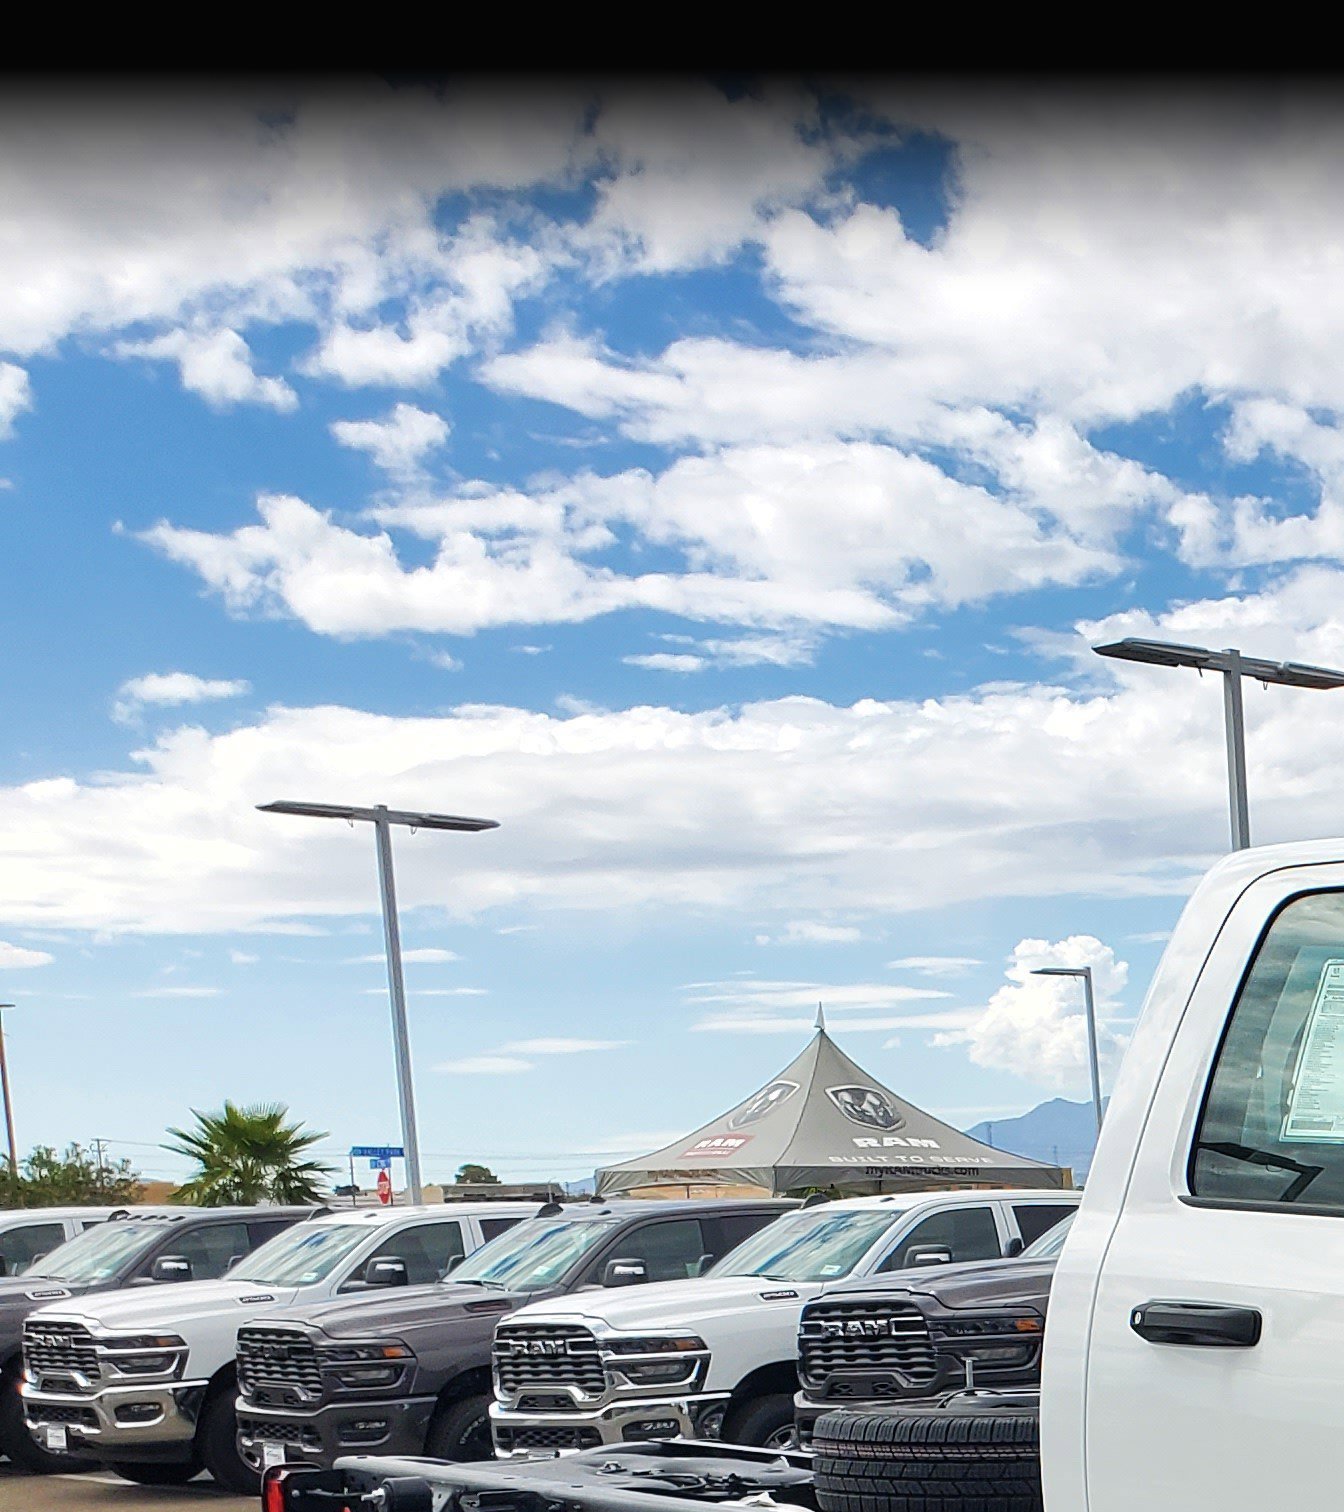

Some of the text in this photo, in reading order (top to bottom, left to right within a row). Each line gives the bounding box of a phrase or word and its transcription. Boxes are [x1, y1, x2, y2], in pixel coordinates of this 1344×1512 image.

[852, 1137, 941, 1149] RAM
[895, 1155, 922, 1163] TO
[928, 1156, 994, 1164] SERVE
[822, 1320, 889, 1337] RAM
[510, 1340, 567, 1355] RAM
